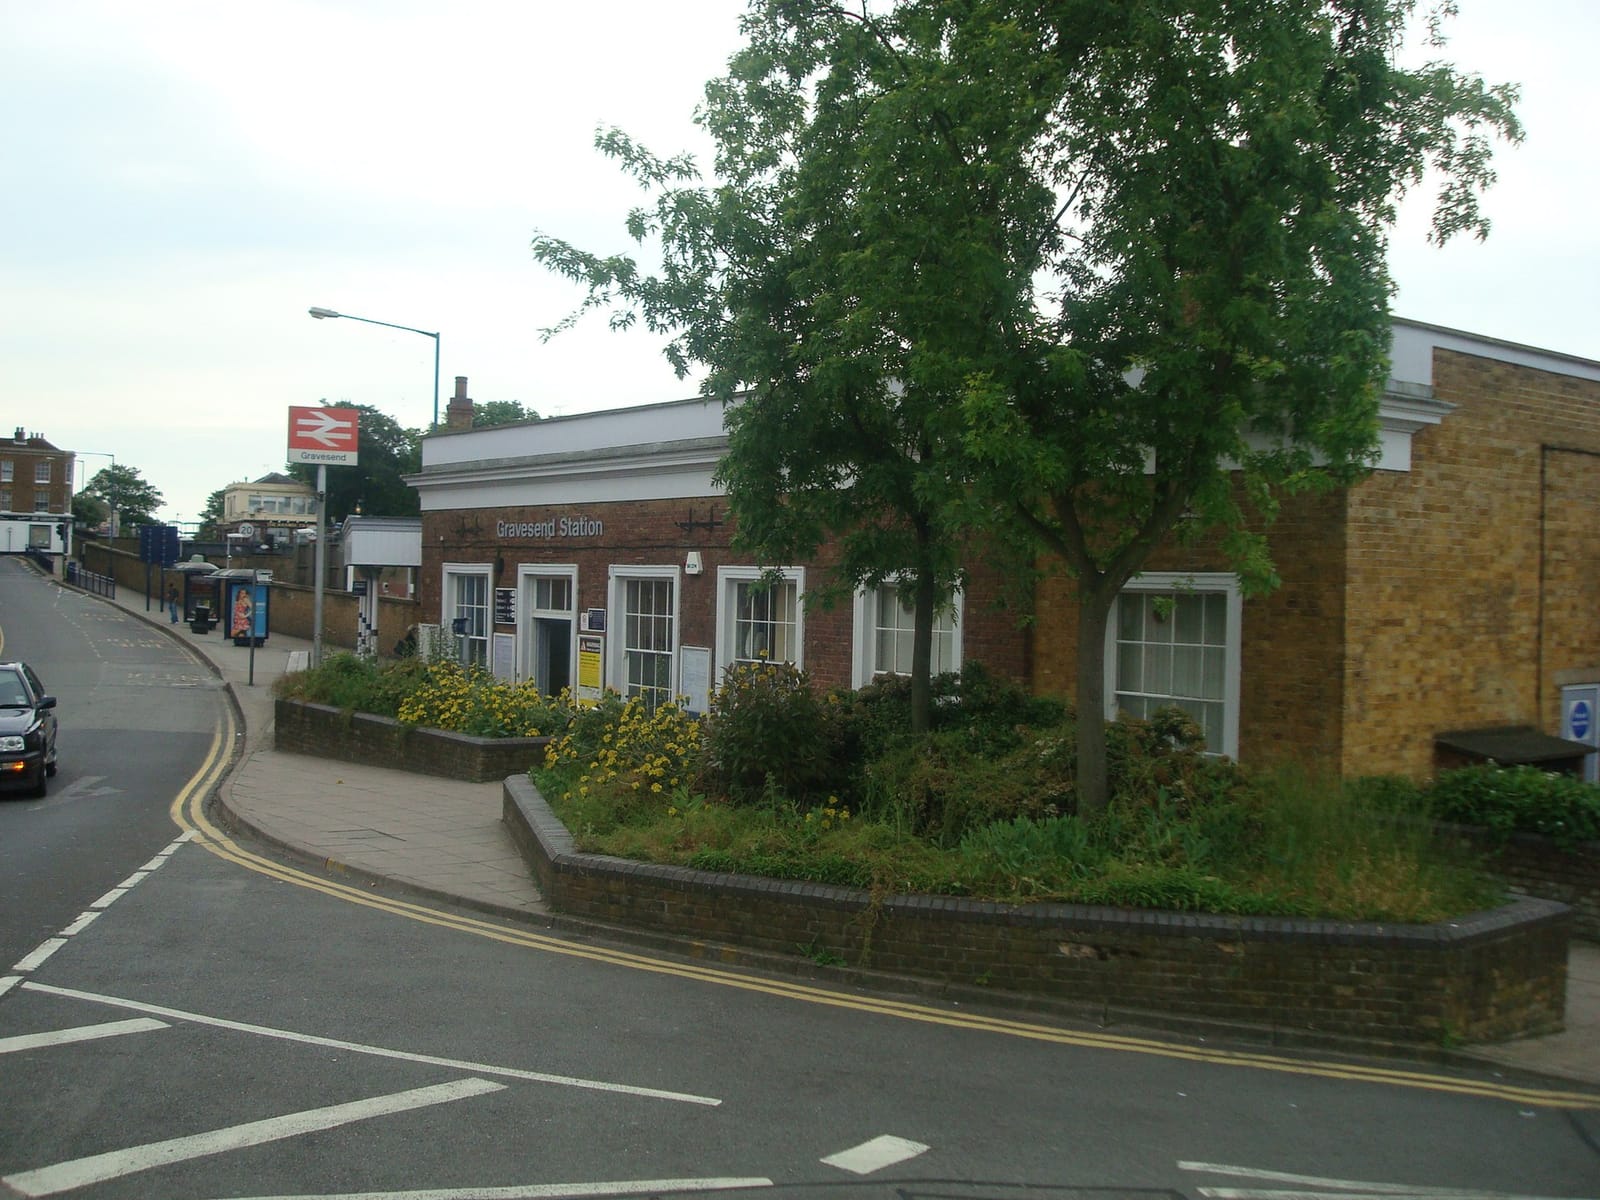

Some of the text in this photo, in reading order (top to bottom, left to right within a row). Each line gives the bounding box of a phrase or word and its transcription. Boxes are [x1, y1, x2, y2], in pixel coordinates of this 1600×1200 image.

[301, 452, 347, 461] Gravesend
[241, 526, 253, 535] 20
[496, 516, 603, 538] Gravesend Station
